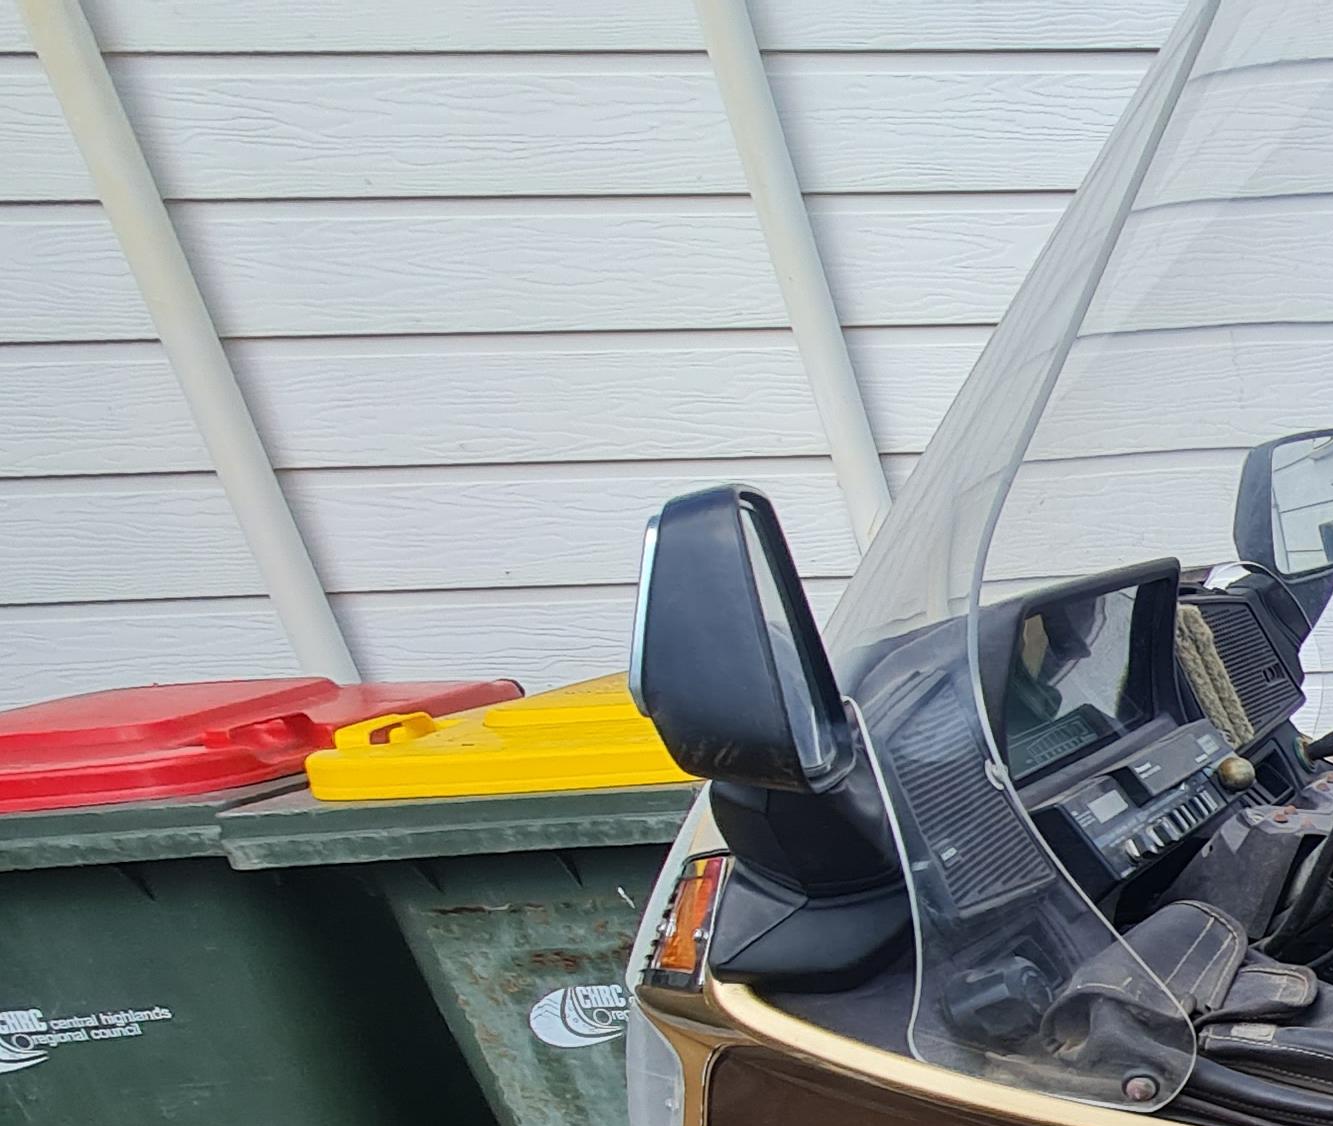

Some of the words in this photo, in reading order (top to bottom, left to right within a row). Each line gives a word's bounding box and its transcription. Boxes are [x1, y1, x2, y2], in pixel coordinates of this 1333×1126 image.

[576, 984, 626, 1008] CHRC
[0, 1009, 48, 1035] CHRC
[51, 1014, 99, 1031] central
[100, 1006, 173, 1027] highlands
[33, 1028, 90, 1047] regional
[90, 1023, 143, 1041] council
